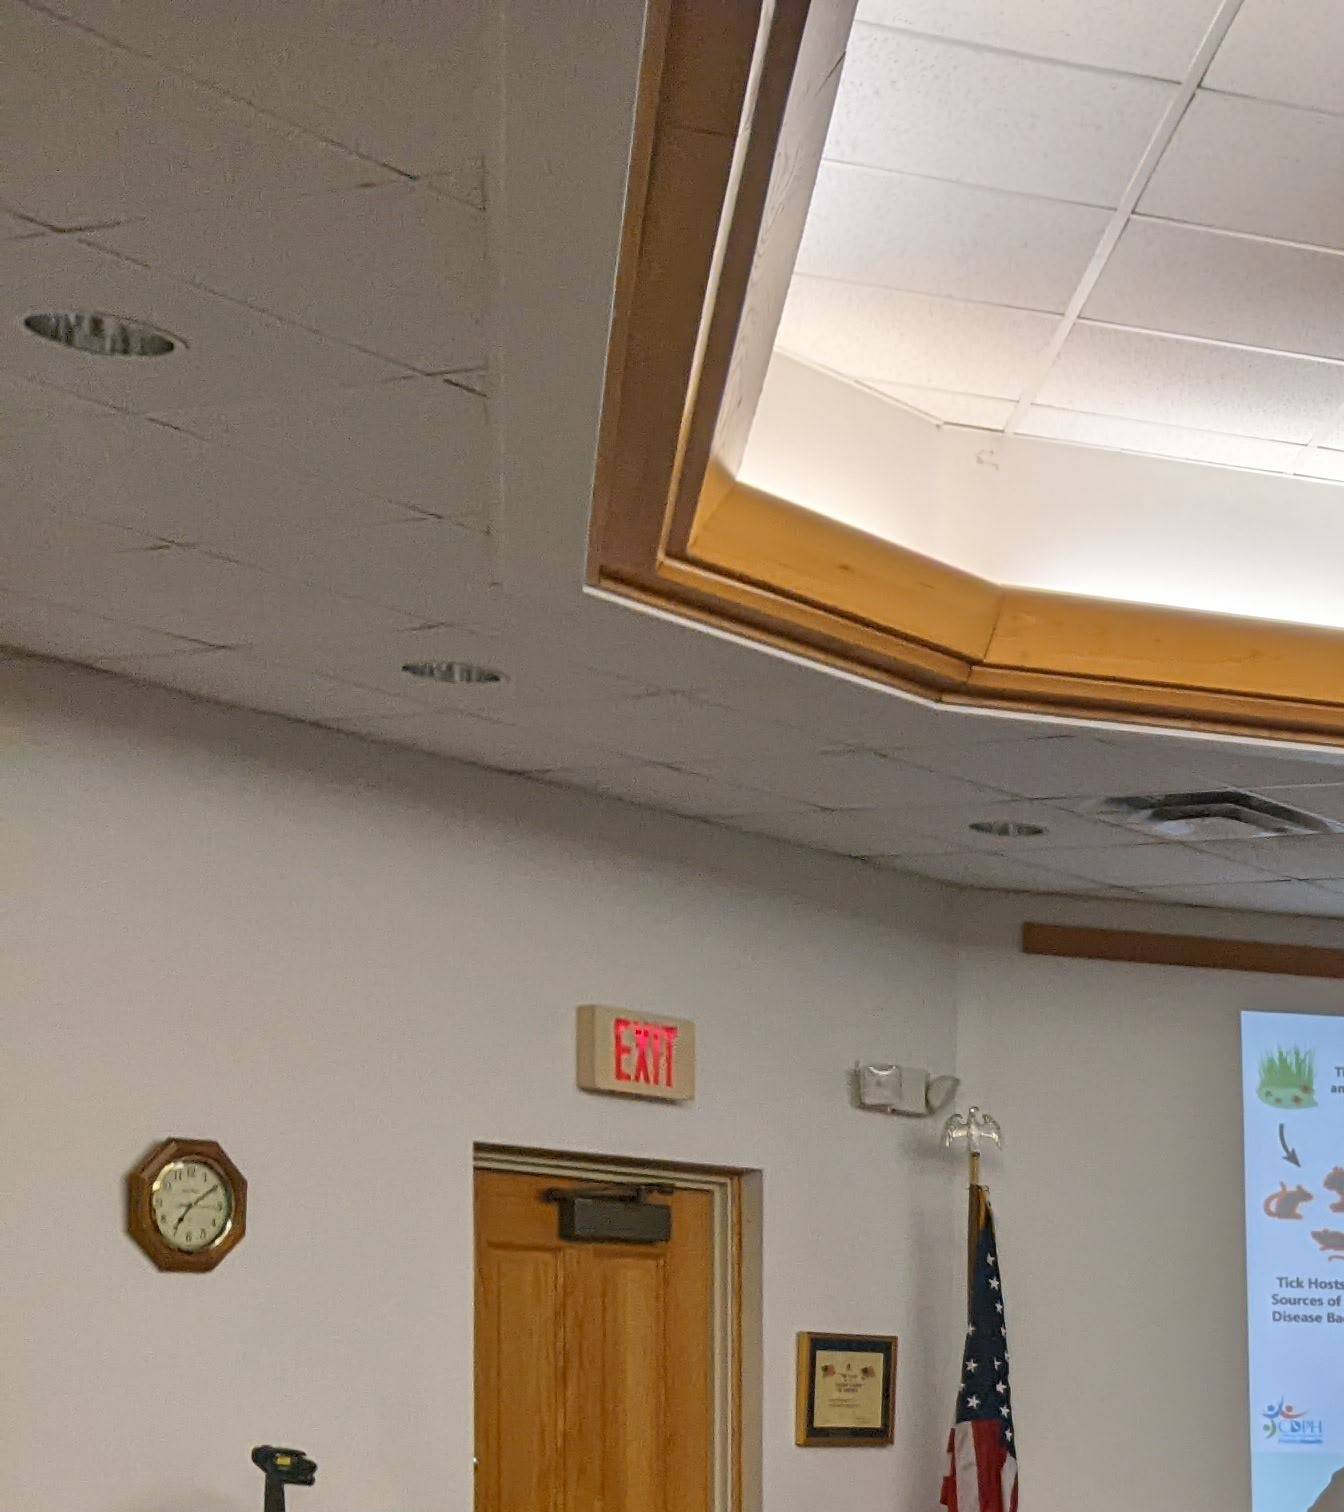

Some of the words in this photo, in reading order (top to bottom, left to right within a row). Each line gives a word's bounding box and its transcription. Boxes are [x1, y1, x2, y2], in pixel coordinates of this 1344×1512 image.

[614, 1018, 678, 1088] EXIT
[1276, 1276, 1305, 1289] Tick
[1271, 1293, 1324, 1307] Sources
[1327, 1295, 1342, 1307] of
[1271, 1310, 1323, 1324] Disease
